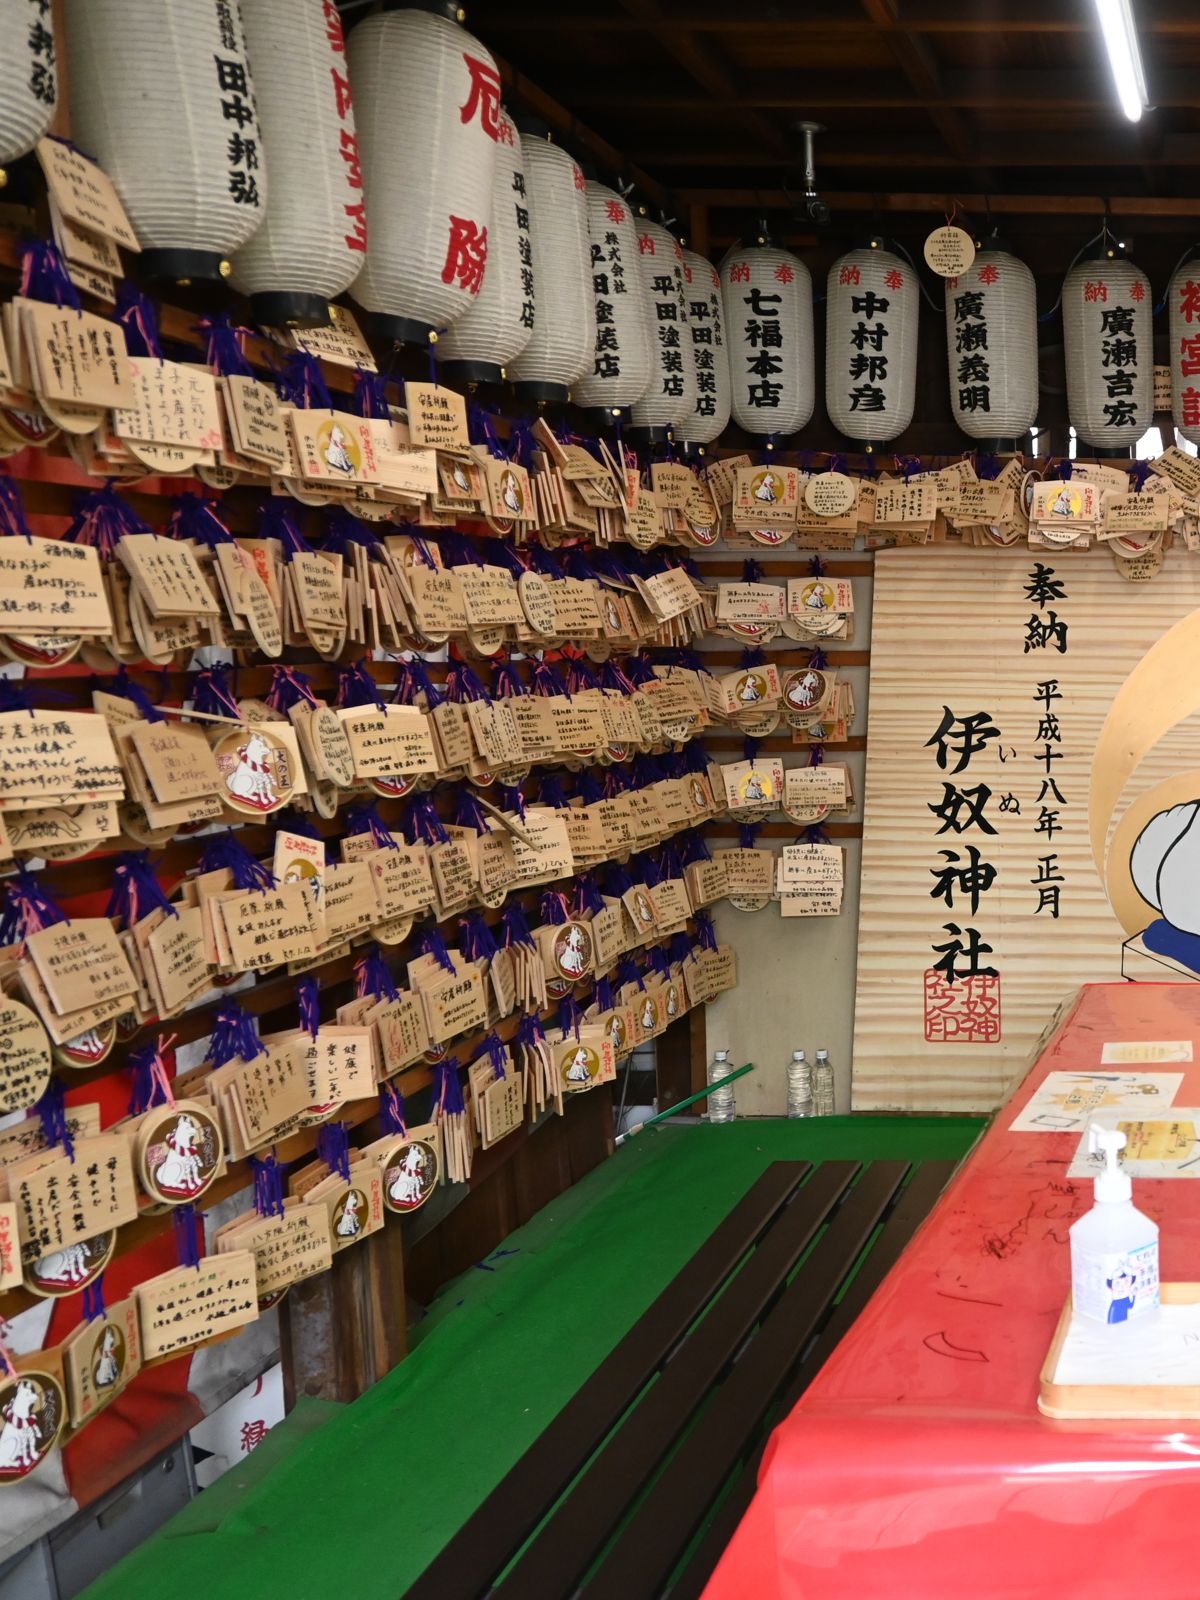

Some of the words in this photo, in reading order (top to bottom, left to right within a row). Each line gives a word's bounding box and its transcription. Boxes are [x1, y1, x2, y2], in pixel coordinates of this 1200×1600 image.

[214, 55, 260, 207] 田中邦弘
[605, 200, 626, 225] 奉
[604, 231, 627, 294] 株式会社
[730, 263, 752, 285] 納
[774, 264, 794, 285] 奉
[839, 266, 861, 287] 納
[884, 270, 904, 291] 奉
[977, 264, 1000, 286] 奉
[1083, 281, 1108, 303] 納
[1130, 280, 1146, 302] 奉
[650, 275, 685, 398] 平田塗装店
[689, 301, 717, 417] 平田塗装店
[743, 288, 784, 408] 七福本店
[848, 291, 890, 412] 中村邦彦
[1023, 563, 1069, 654] 奉納
[1033, 680, 1067, 840] 平成十八年
[927, 705, 1001, 985] 伊奴神社
[1031, 853, 1066, 918] 正月
